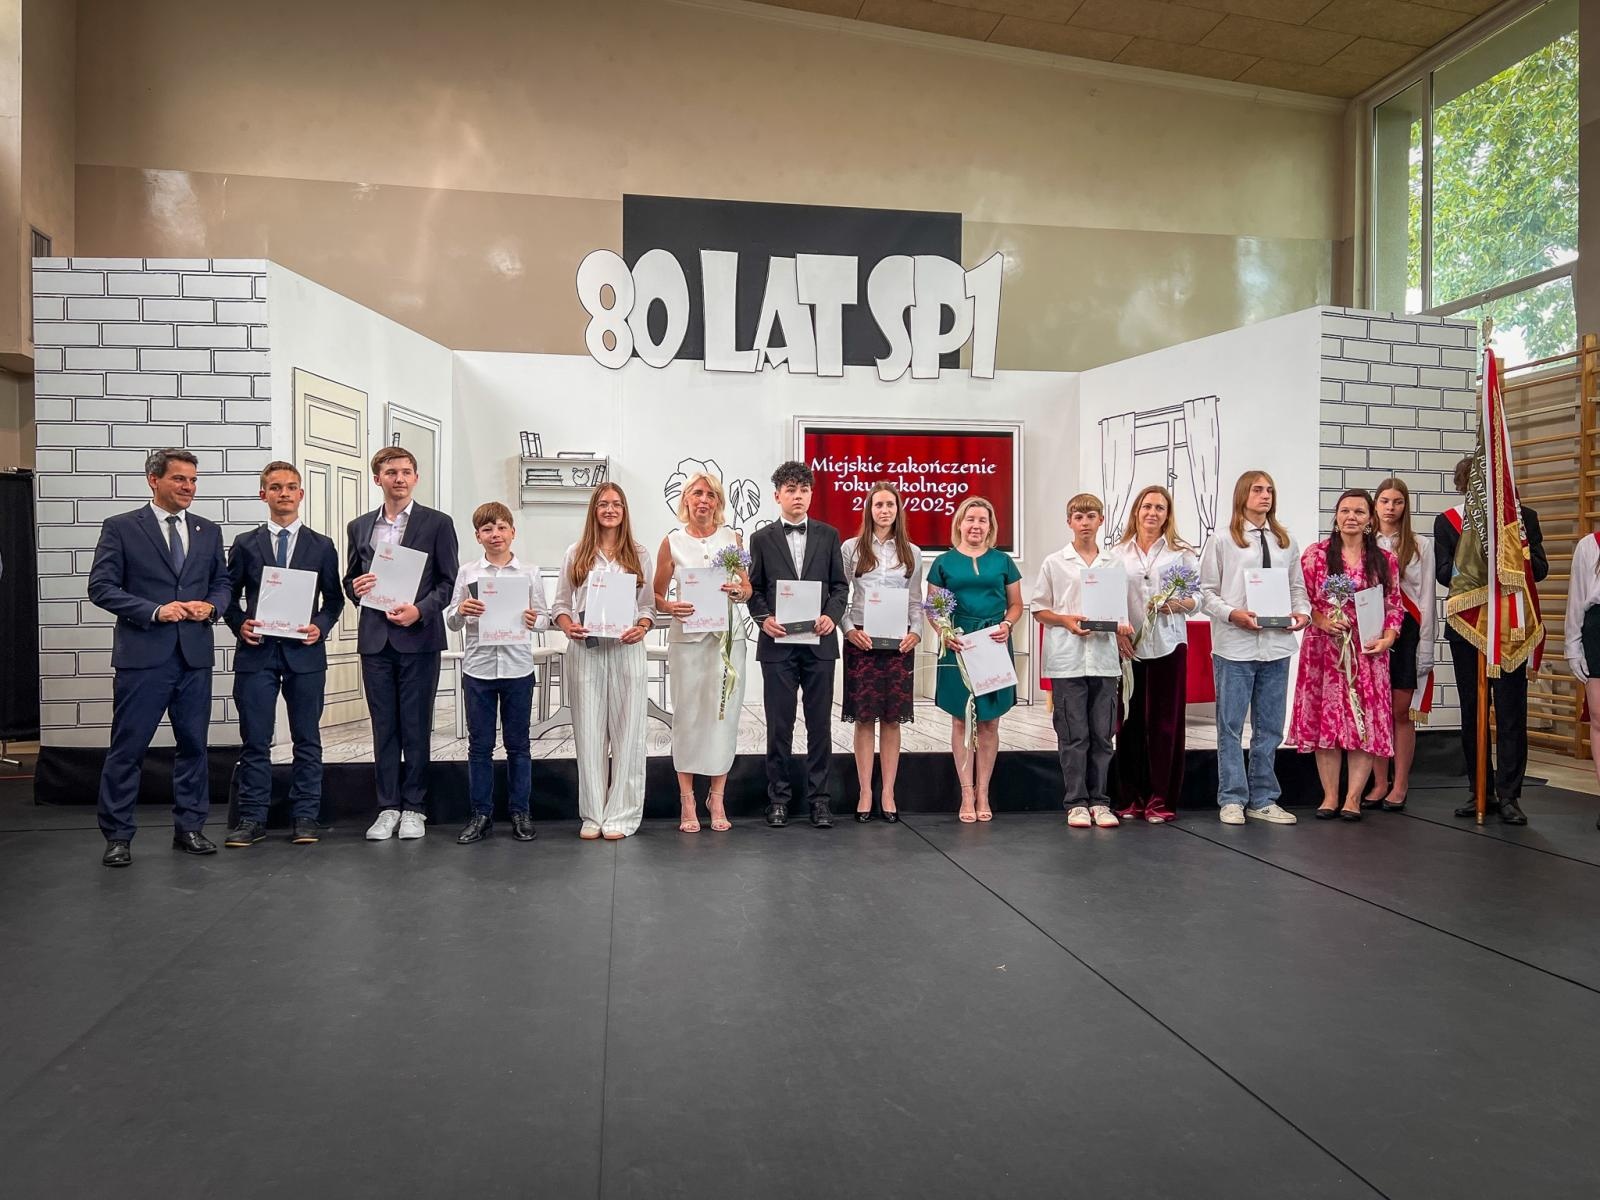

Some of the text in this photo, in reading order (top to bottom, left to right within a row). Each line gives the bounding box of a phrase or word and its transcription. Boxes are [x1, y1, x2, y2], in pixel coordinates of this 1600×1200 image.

[576, 248, 1004, 382] 80 LAT SP1
[811, 455, 997, 478] Miejskie zakończenie
[833, 474, 969, 498] roku zkolnego
[852, 496, 956, 516] 2/2025
[1470, 508, 1489, 559] ŚLĄSKIC
